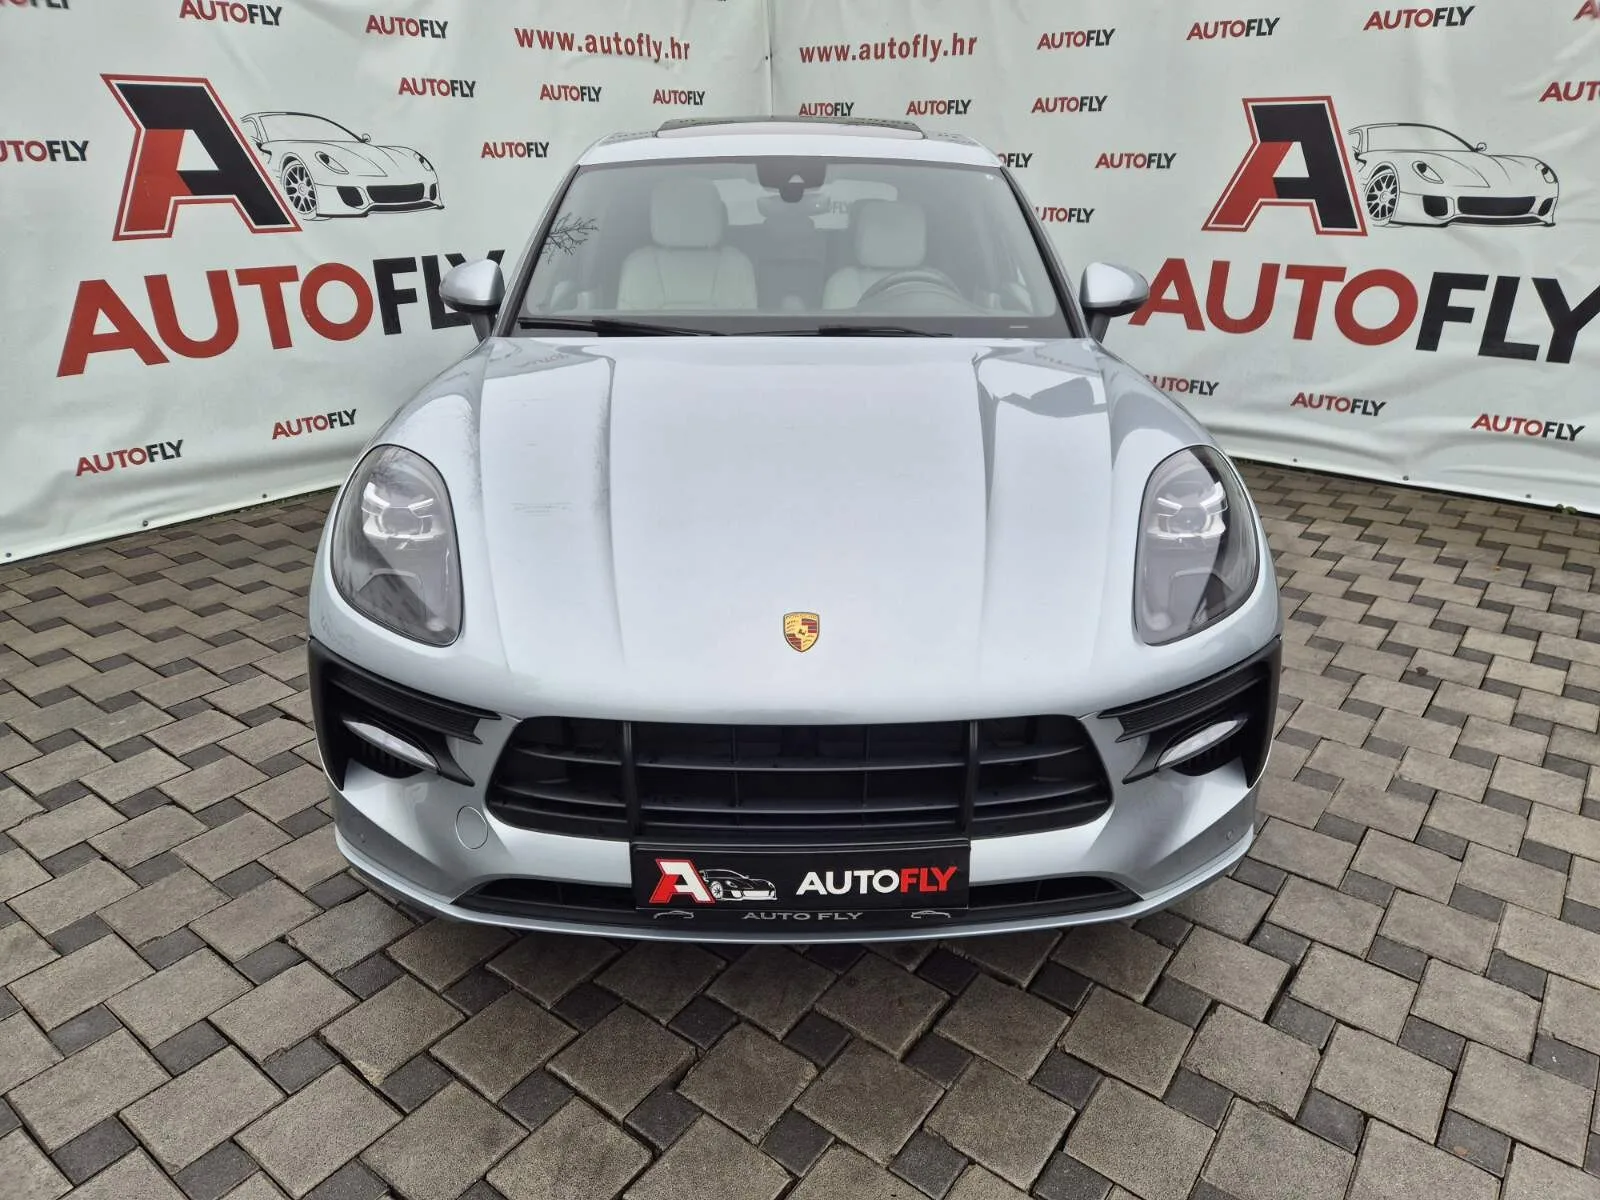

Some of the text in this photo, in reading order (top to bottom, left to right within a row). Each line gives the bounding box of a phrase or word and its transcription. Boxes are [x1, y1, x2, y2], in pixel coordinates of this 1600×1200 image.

[180, 0, 282, 26] AUTOFLY
[1363, 6, 1475, 31] AUTOFLY
[365, 14, 449, 39] AUTOFLY
[1186, 17, 1280, 41] AUTOFLY
[514, 27, 690, 63] www.autofly.hr
[800, 32, 978, 63] www.autofly.hr
[1037, 28, 1116, 50] AUTOFLY
[399, 77, 476, 98] AUTOFLY
[540, 84, 602, 102] AUTOFLY
[653, 89, 705, 105] AUTOFLY
[1538, 80, 1600, 102] AUT
[799, 102, 854, 117] AUTOFLY
[906, 99, 972, 115] AUTOFLY
[1031, 95, 1108, 114] AUTOFLY
[481, 142, 549, 158] AUTOFLY
[1095, 152, 1177, 169] AUTOFLY
[1128, 257, 1600, 364] AUTOFLY
[1290, 392, 1386, 417] AUTOFLY
[271, 408, 357, 440] AUTOFLY
[1471, 413, 1585, 442] AUTOFLY
[75, 439, 183, 477] AUTOFLY
[796, 866, 957, 896] AUTOFLY
[742, 911, 864, 921] AUTO FLY
